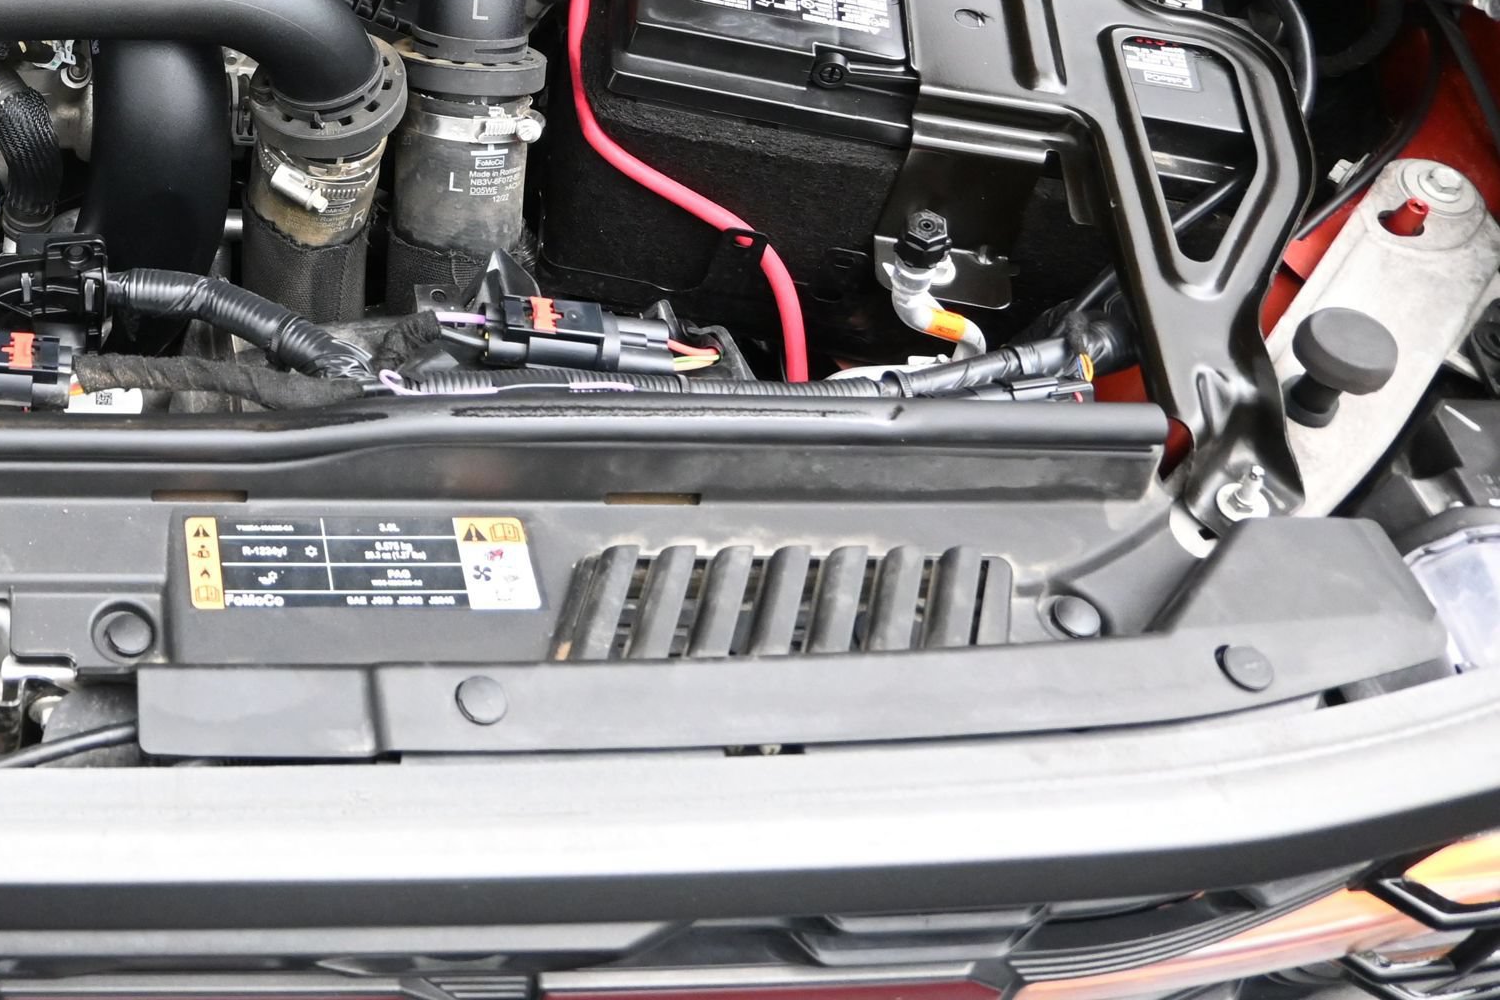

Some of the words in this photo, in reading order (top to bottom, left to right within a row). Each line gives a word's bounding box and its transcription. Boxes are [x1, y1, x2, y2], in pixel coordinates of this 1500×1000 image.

[477, 159, 504, 167] FoMoCo
[449, 171, 464, 192] L
[351, 208, 366, 229] R
[224, 593, 285, 607] FoMoCo
